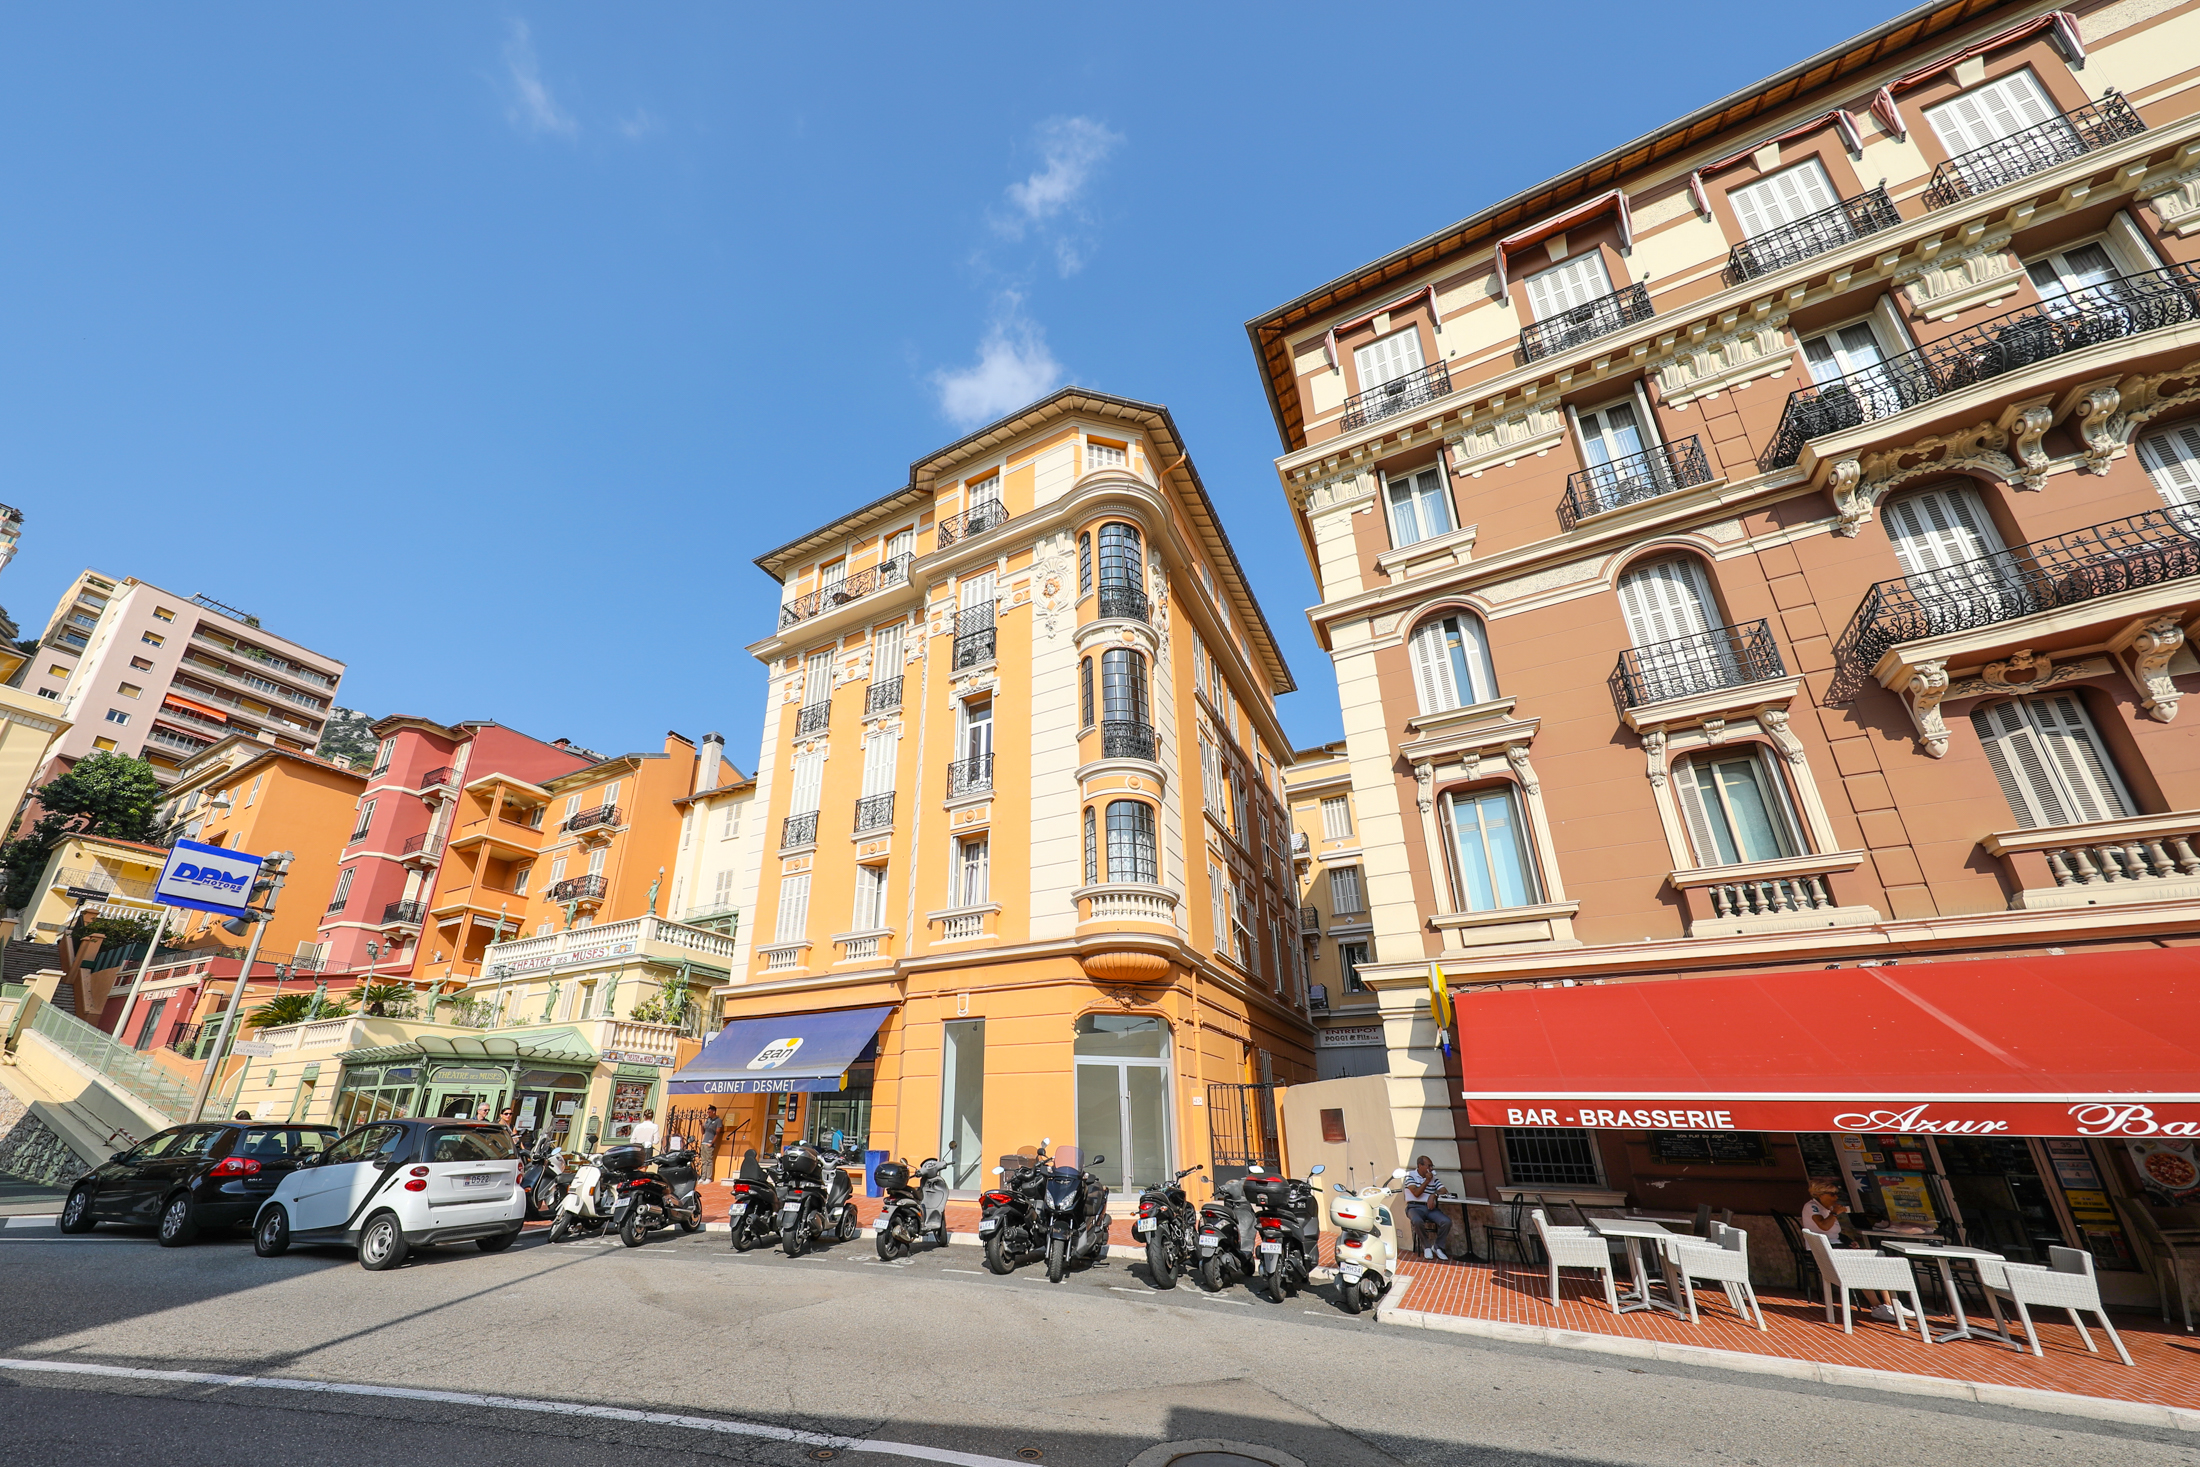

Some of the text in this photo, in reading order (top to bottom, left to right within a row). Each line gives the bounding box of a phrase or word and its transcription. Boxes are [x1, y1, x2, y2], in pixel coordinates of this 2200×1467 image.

[171, 862, 250, 886] DPM
[202, 879, 243, 891] MOTORS
[571, 947, 605, 962] MUSES
[142, 988, 179, 1001] PEINTURE
[1325, 1027, 1377, 1035] ENTREPOT
[757, 1048, 794, 1062] gan
[479, 1072, 503, 1080] MUSES
[703, 1079, 796, 1093] CABINET DESMET
[1506, 1108, 1560, 1126] BAR
[1578, 1109, 1736, 1129] BRASSERIE
[1832, 1103, 2009, 1132] Azur
